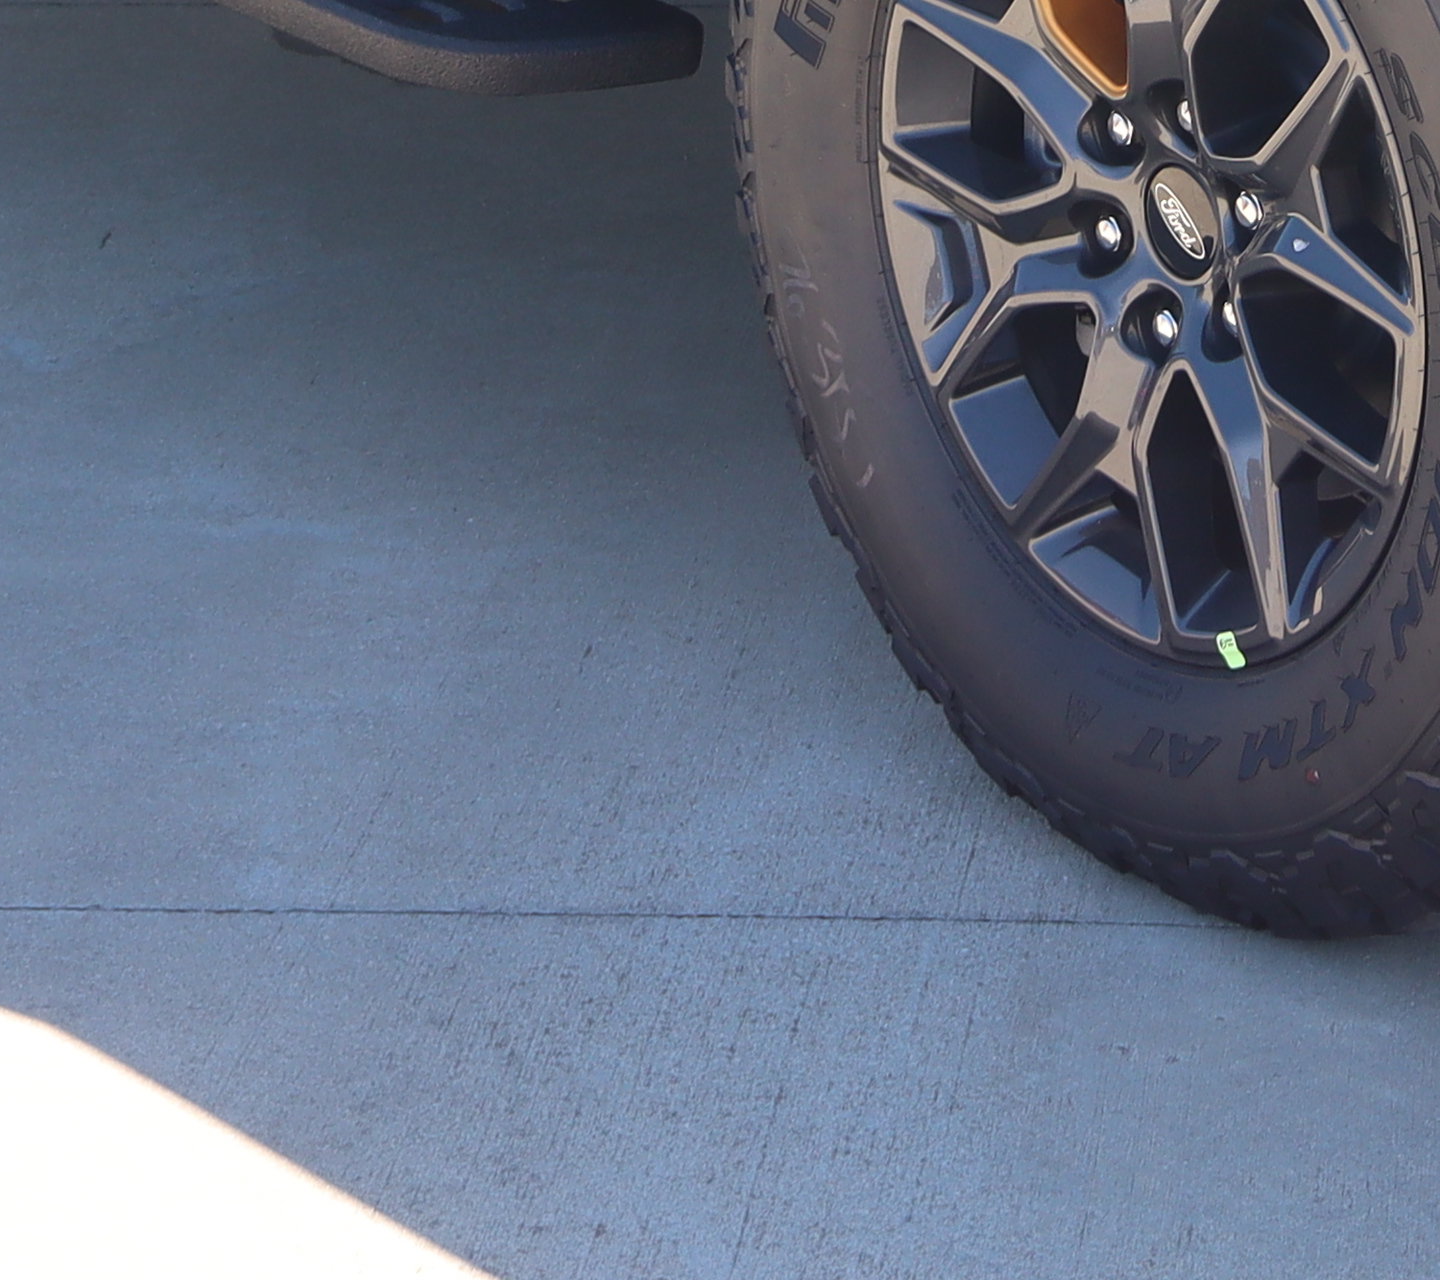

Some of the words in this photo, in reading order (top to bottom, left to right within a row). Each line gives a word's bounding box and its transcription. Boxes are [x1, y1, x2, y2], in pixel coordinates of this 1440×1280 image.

[1160, 197, 1197, 249] Ford
[1237, 643, 1377, 782] XTM
[1112, 725, 1222, 779] AT
